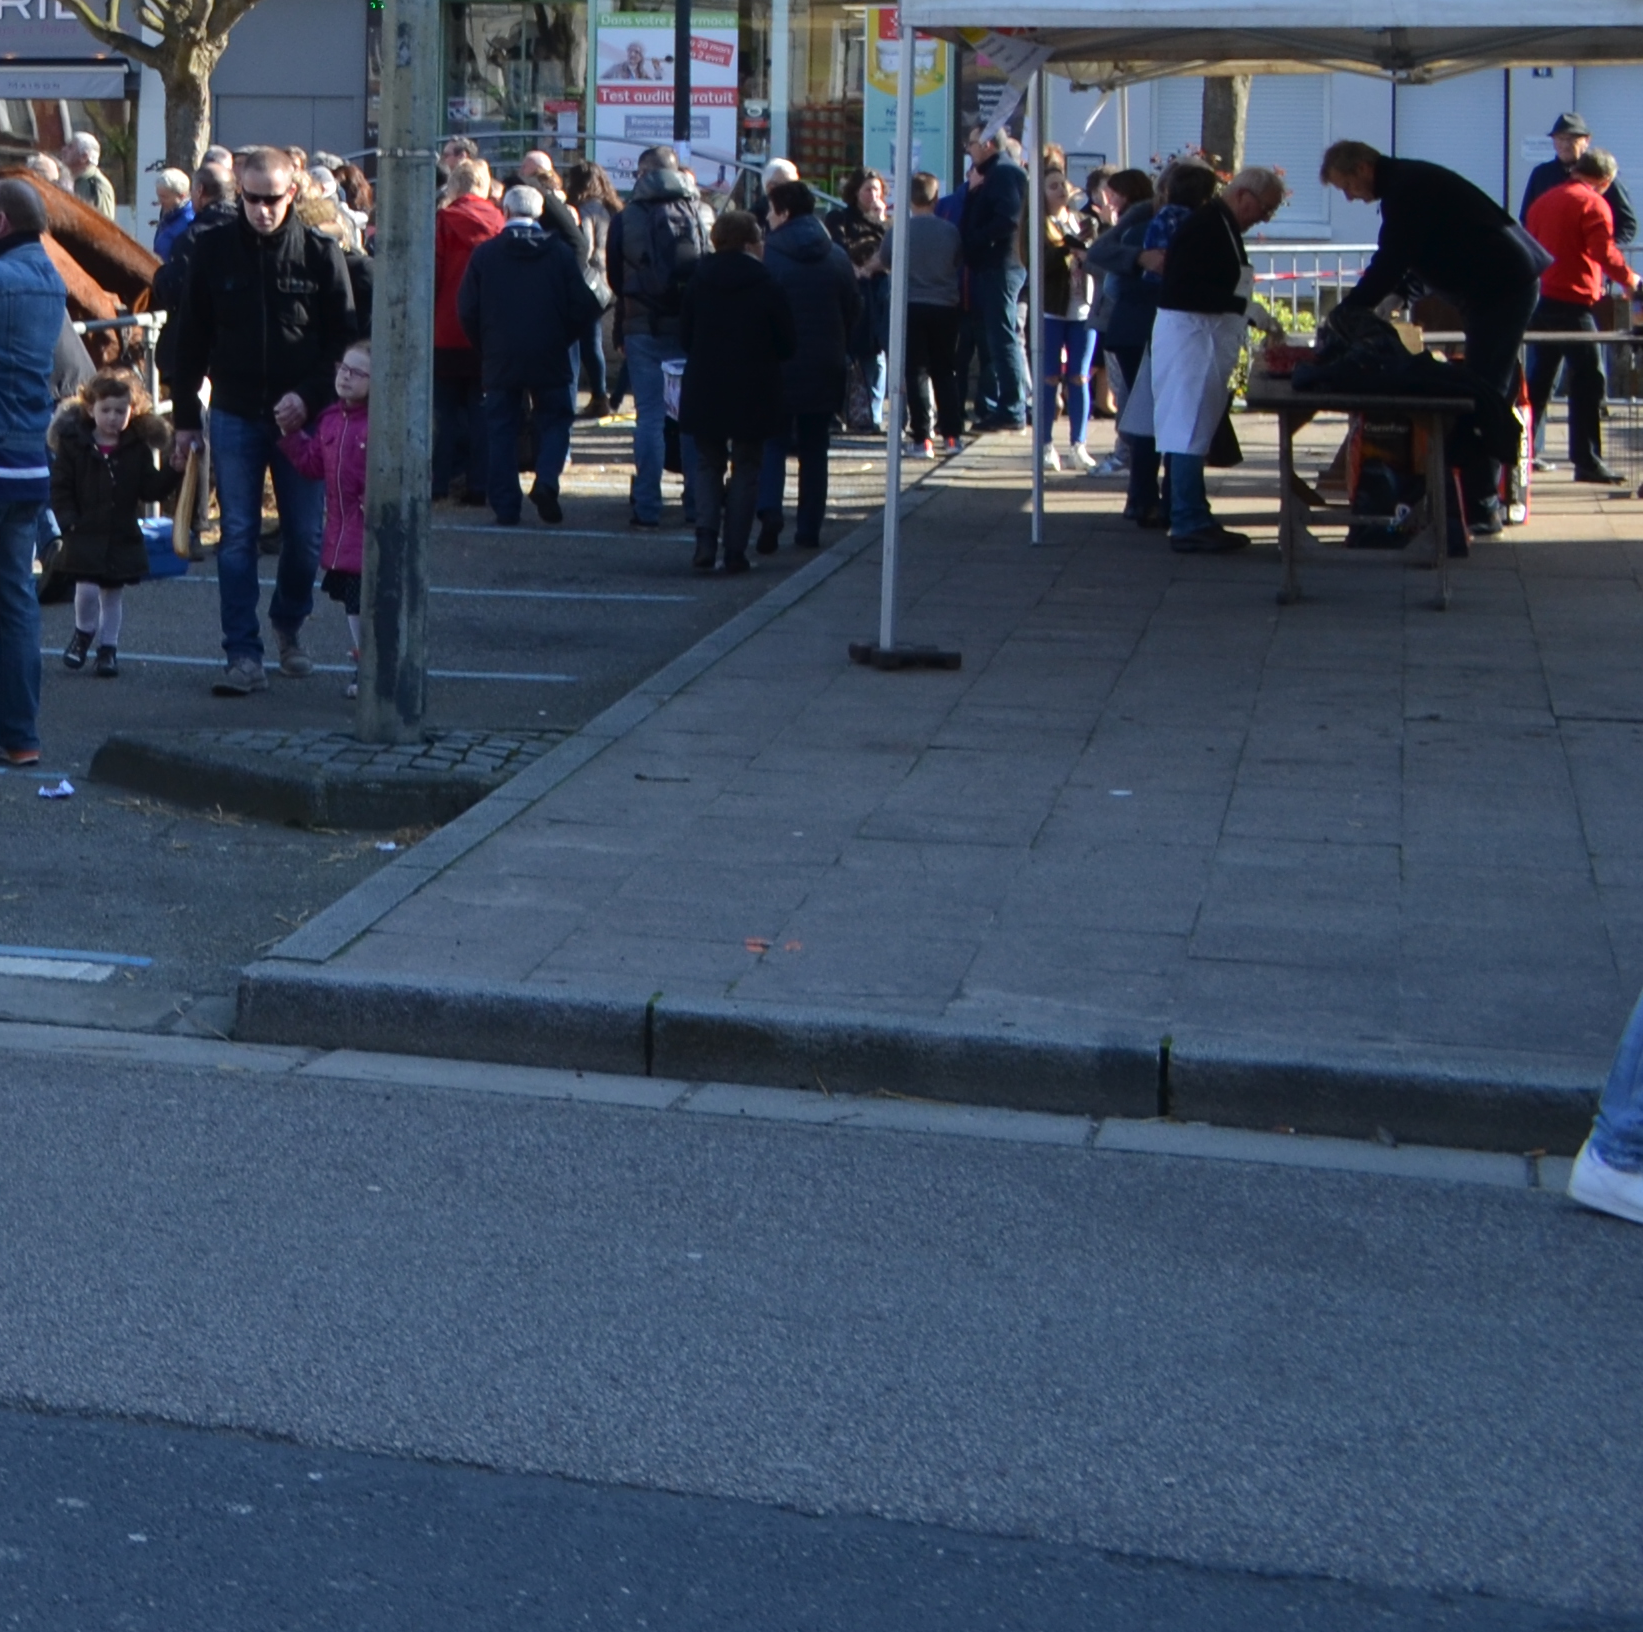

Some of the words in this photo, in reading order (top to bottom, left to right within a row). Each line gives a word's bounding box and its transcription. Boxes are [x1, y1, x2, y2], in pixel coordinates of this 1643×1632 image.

[601, 15, 632, 26] Dans
[635, 16, 666, 26] votre
[668, 15, 736, 28] prmacie
[600, 88, 630, 103] Test
[633, 89, 676, 103] auditi
